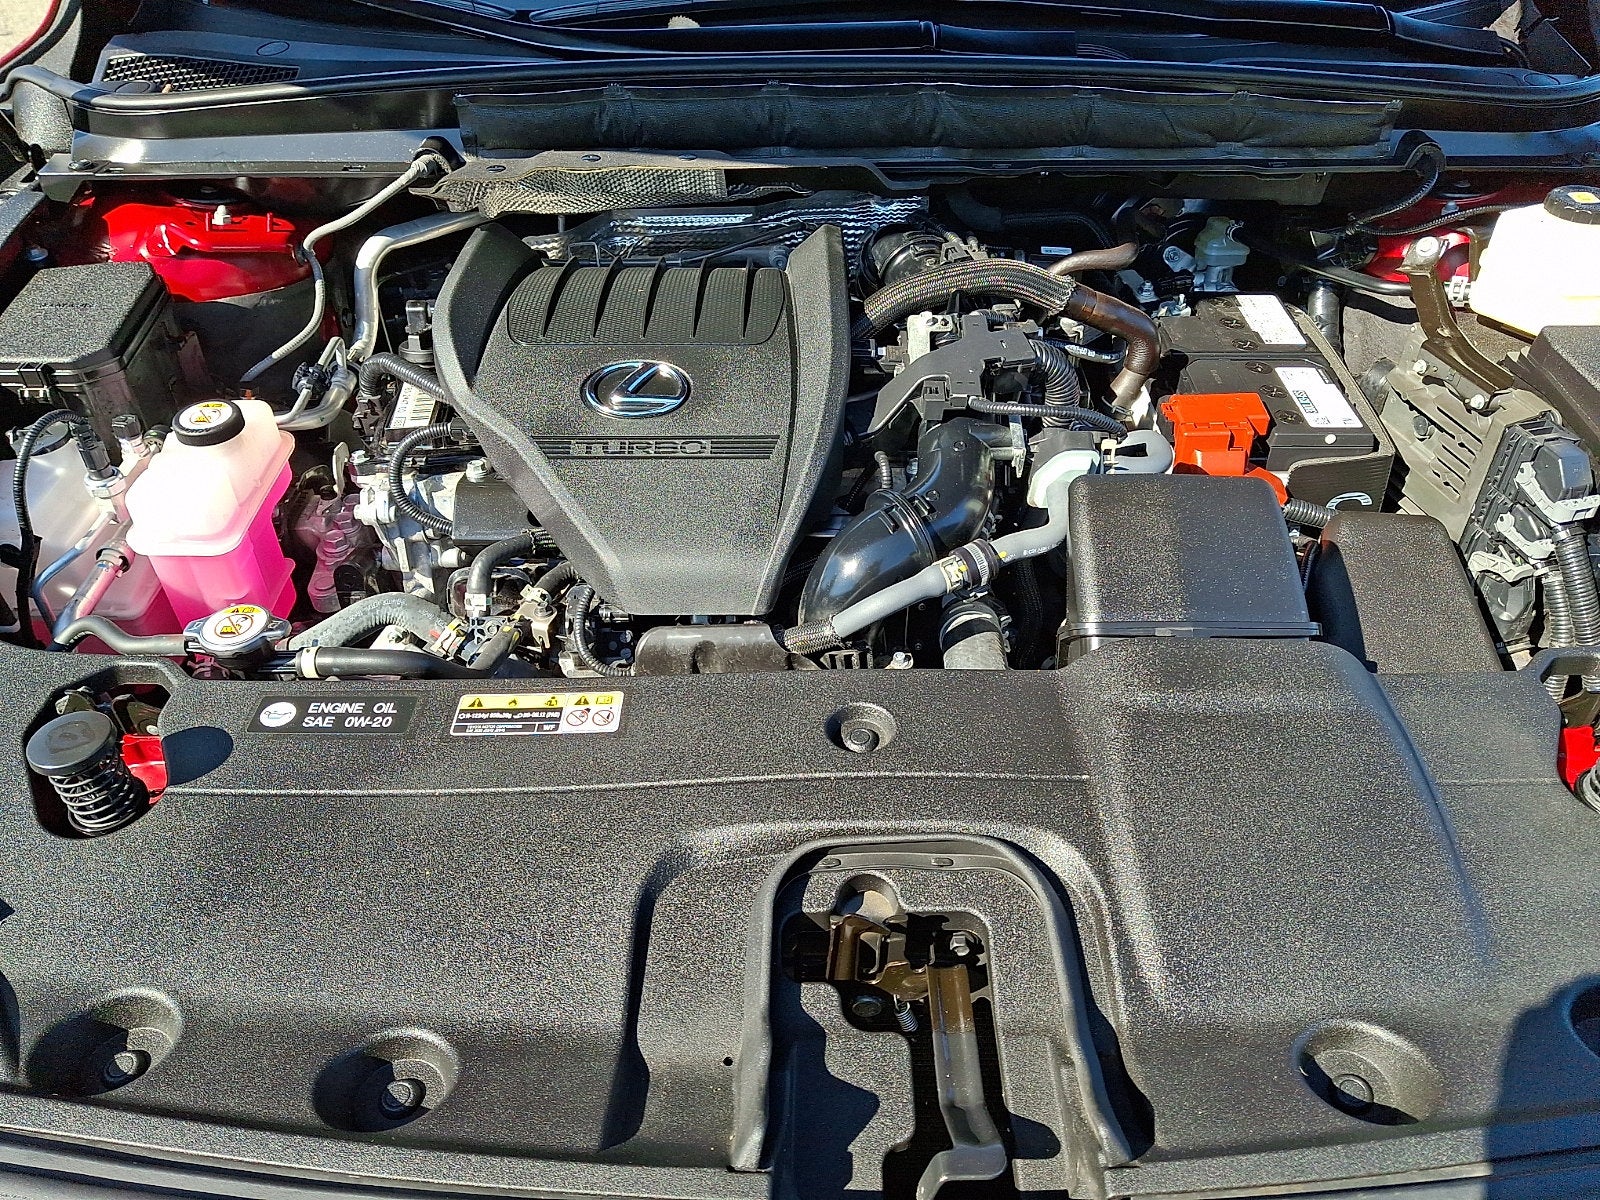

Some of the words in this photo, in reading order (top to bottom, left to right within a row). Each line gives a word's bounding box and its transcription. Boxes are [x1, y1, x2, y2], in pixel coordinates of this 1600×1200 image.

[572, 439, 709, 455] TURBO
[307, 702, 366, 714] ENGINE
[372, 702, 398, 714] OIL
[302, 716, 336, 728] SAE
[344, 716, 393, 728] 0W-20
